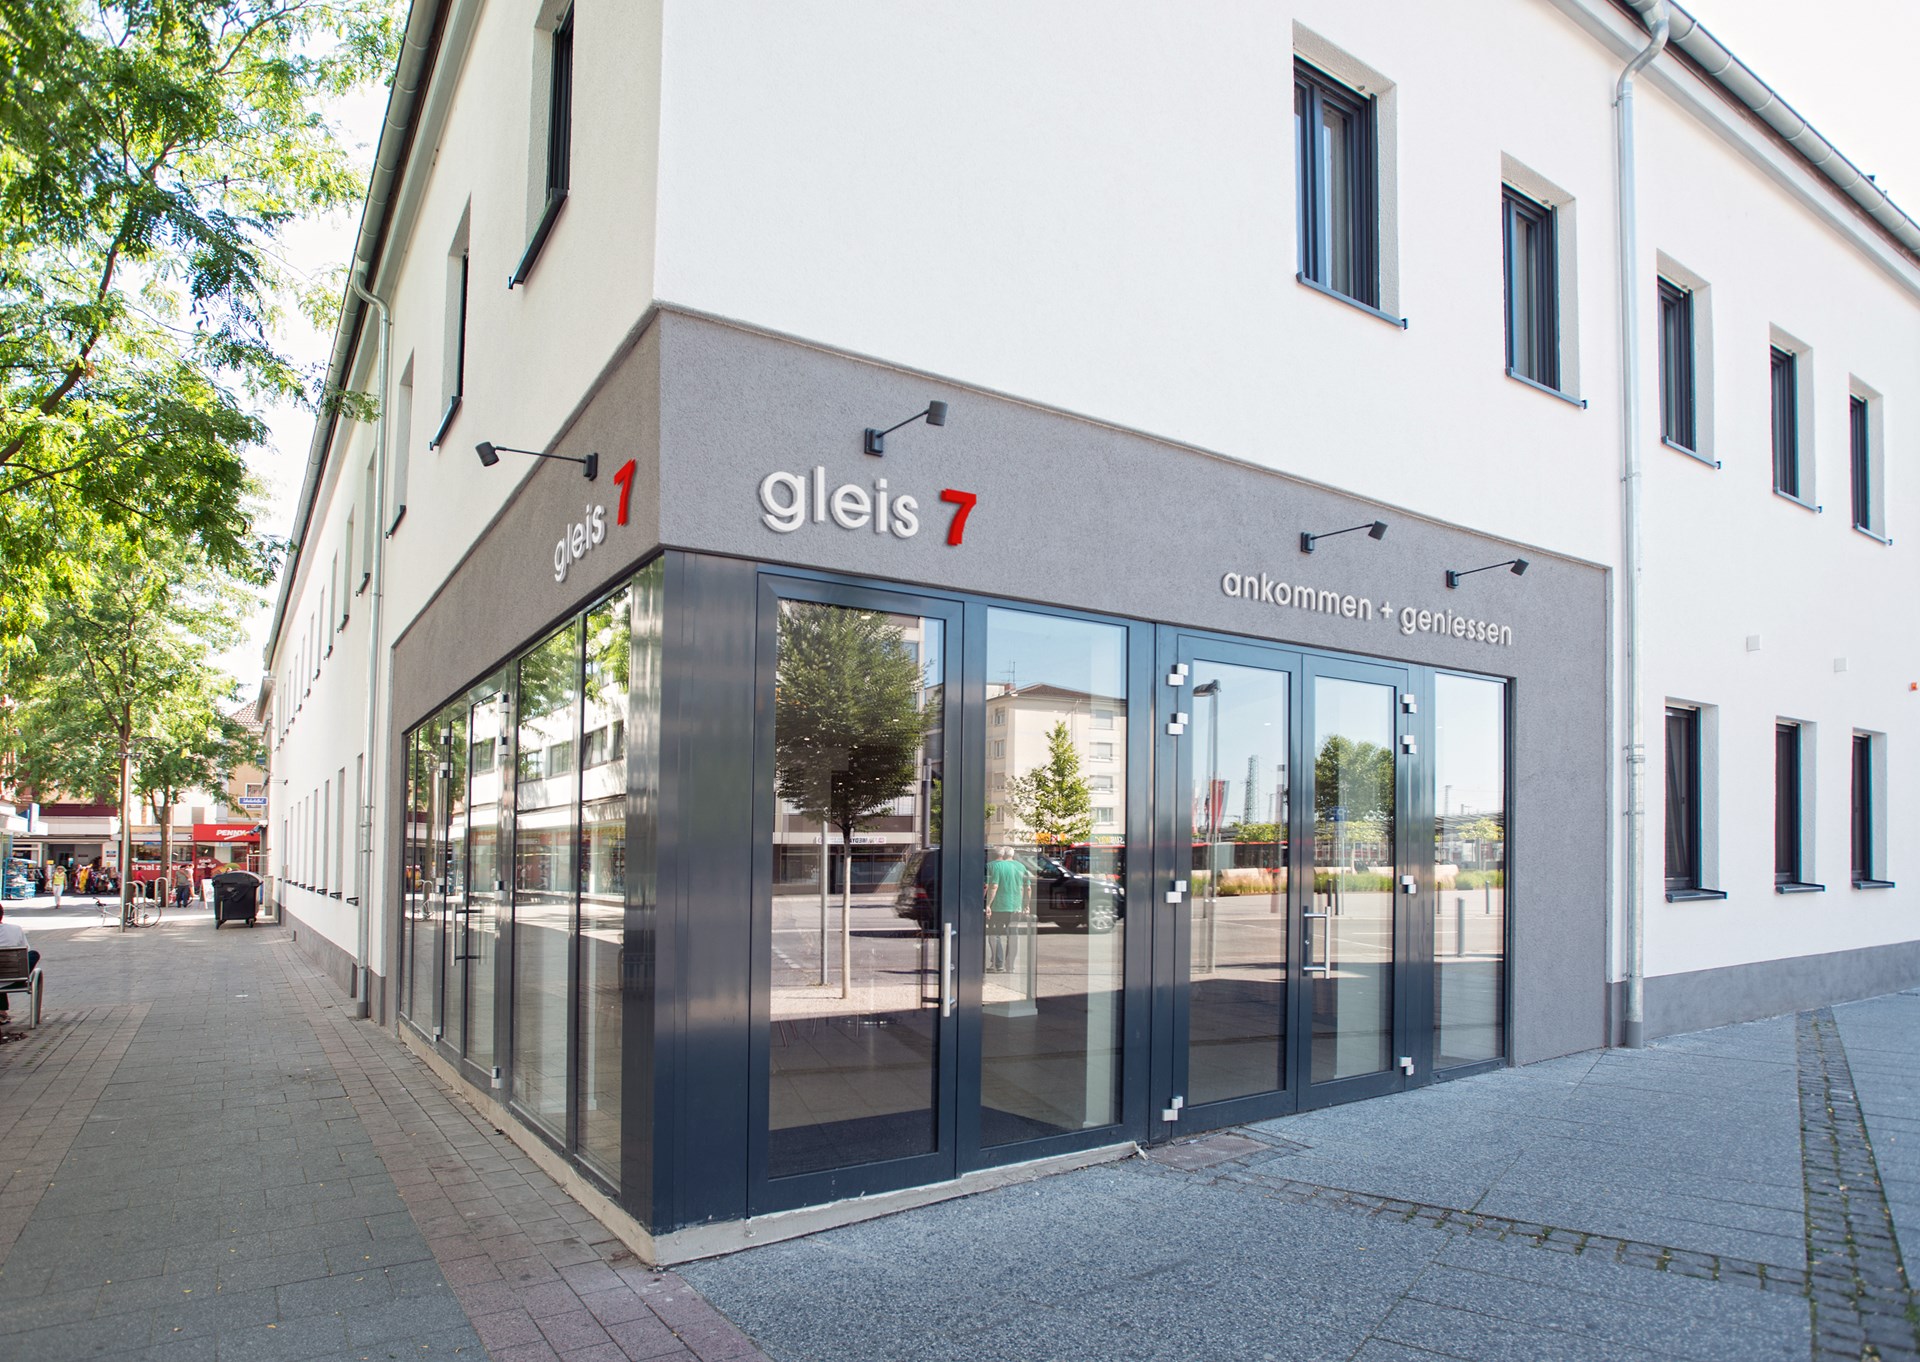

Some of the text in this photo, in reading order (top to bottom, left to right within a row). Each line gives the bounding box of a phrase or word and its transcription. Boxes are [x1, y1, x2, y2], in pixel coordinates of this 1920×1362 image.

[554, 504, 606, 583] gleis
[760, 466, 977, 546] gleis 7
[1222, 572, 1372, 620] ankommen
[1401, 605, 1512, 646] geniessen
[216, 829, 246, 837] PENNY
